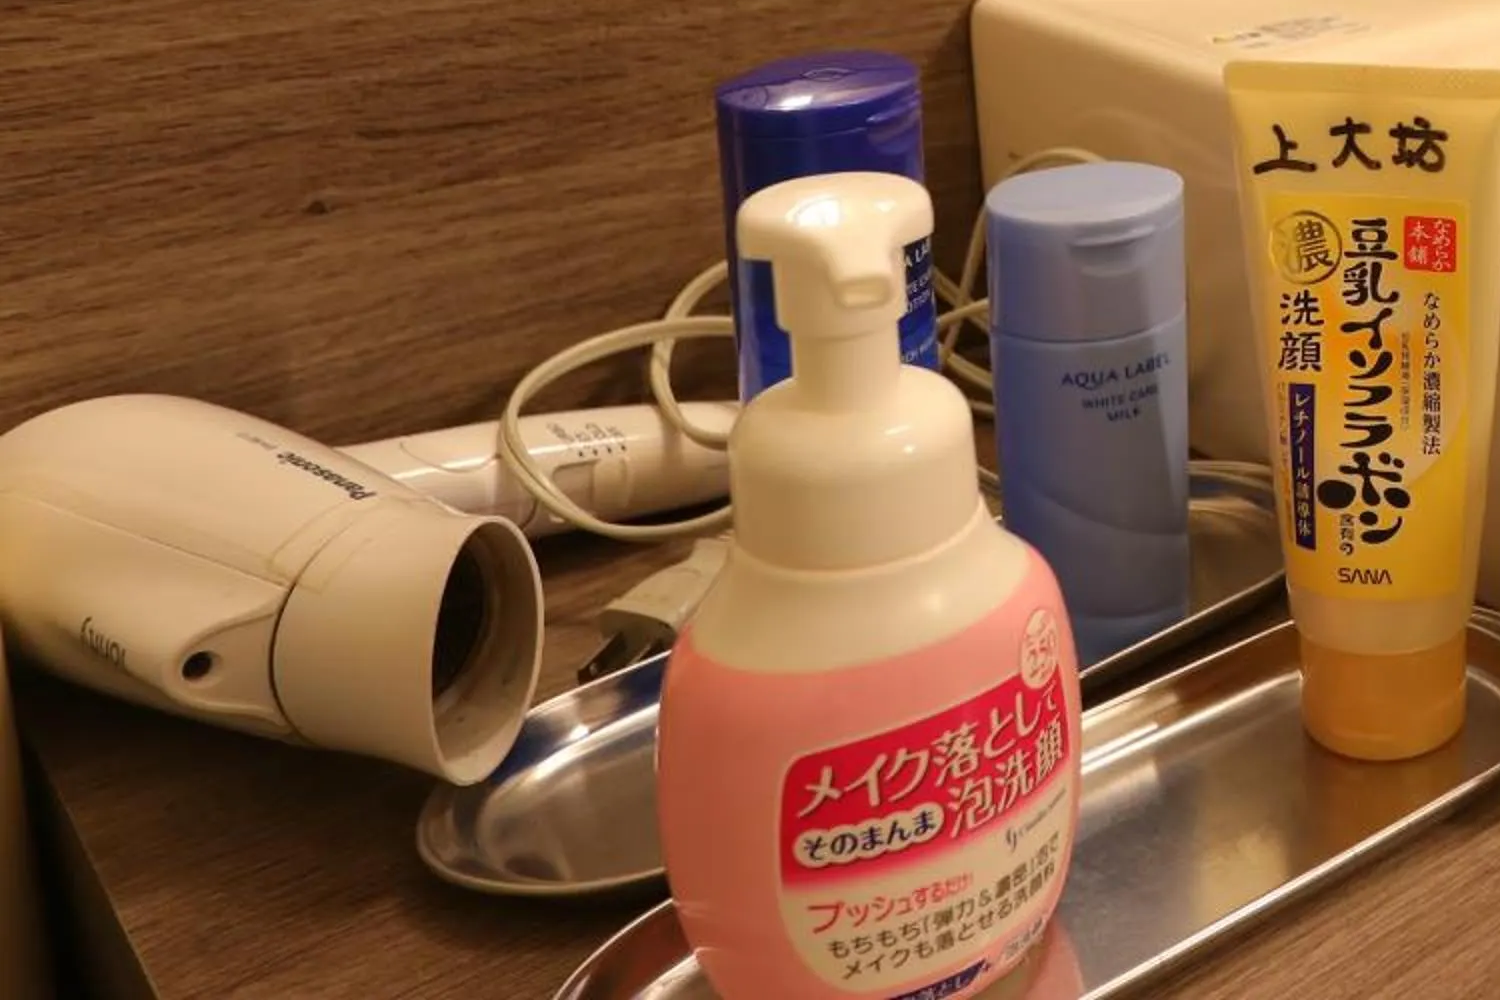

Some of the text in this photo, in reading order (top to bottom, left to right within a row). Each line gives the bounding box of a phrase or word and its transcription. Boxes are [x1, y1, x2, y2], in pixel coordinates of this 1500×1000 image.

[1278, 290, 1324, 372] 洗顔
[1060, 367, 1119, 391] AQUA
[1317, 217, 1411, 545] 豆乳イソフラボン
[1337, 567, 1393, 585] SANA
[796, 683, 1058, 819] メイク落として
[947, 720, 1065, 838] 泡洗顔
[803, 809, 938, 861] そのまんま
